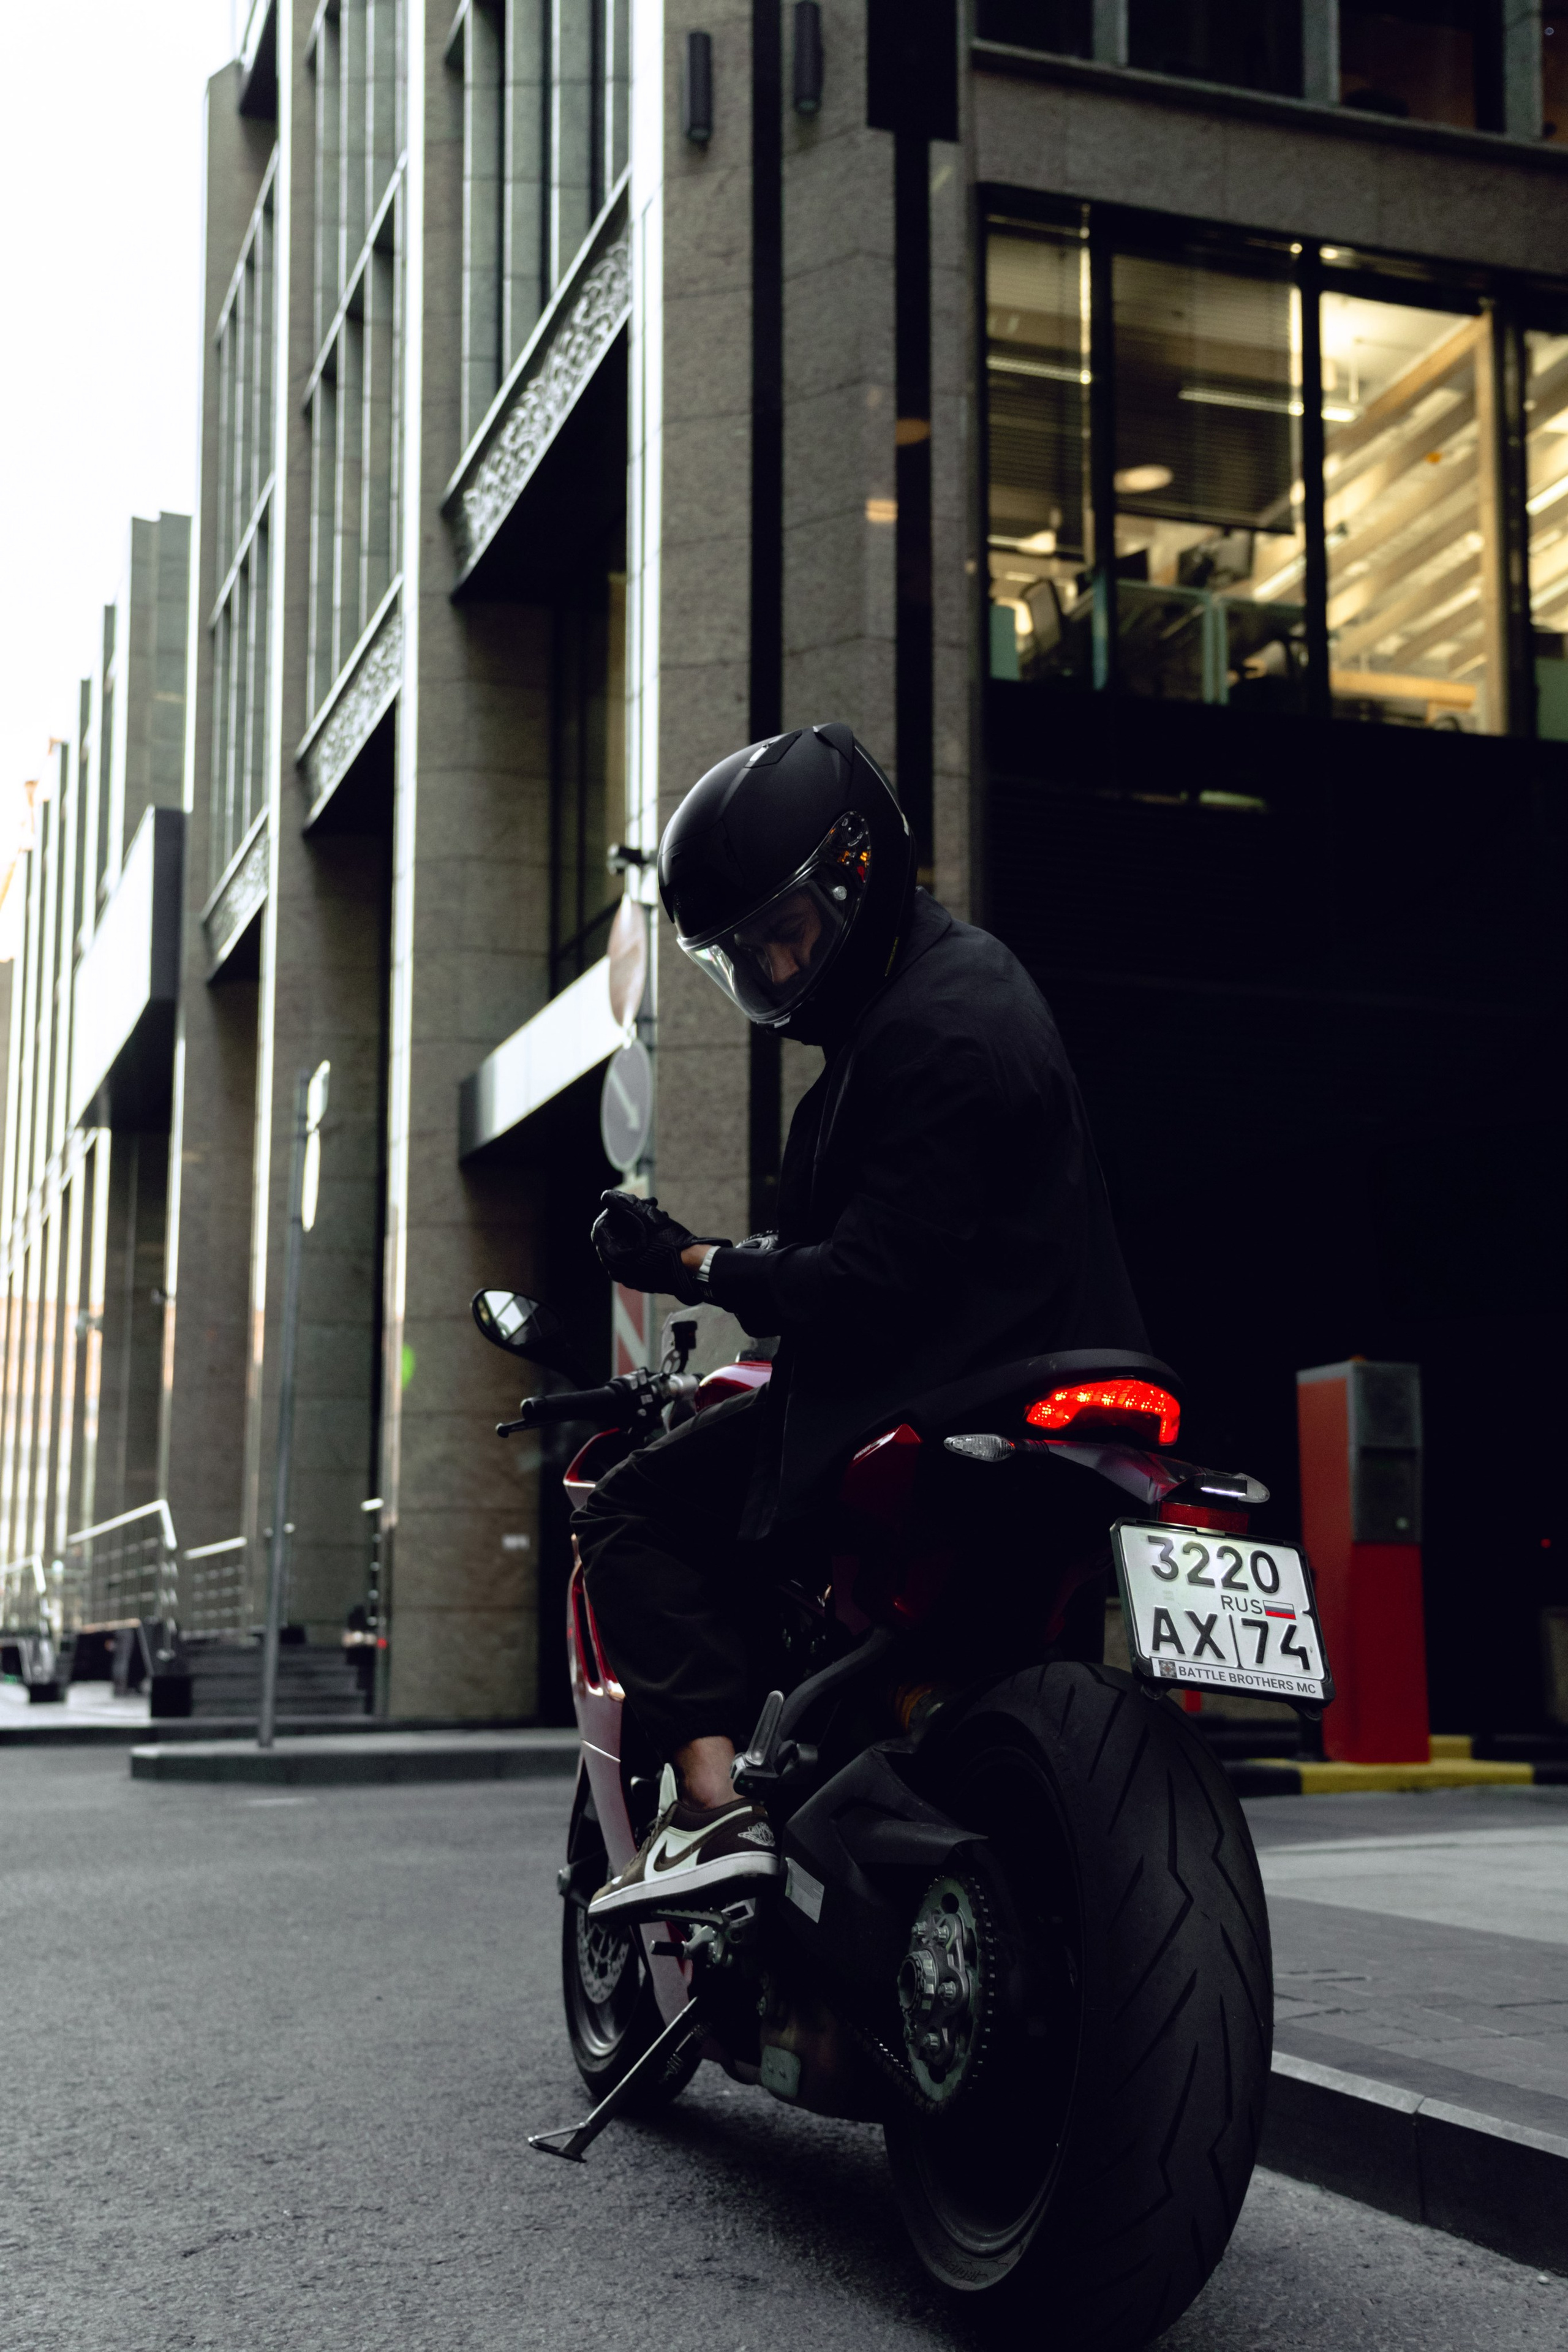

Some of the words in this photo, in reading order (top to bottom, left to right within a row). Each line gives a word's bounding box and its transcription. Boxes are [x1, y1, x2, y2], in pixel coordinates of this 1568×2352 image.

[1147, 1536, 1280, 1593] 3220
[1221, 1595, 1263, 1614] RUS
[1152, 1606, 1226, 1659] AX
[1241, 1618, 1311, 1670] 74
[1179, 1666, 1226, 1682] BATTLE
[1229, 1673, 1294, 1691] BROTHERS
[1297, 1682, 1316, 1694] MC
